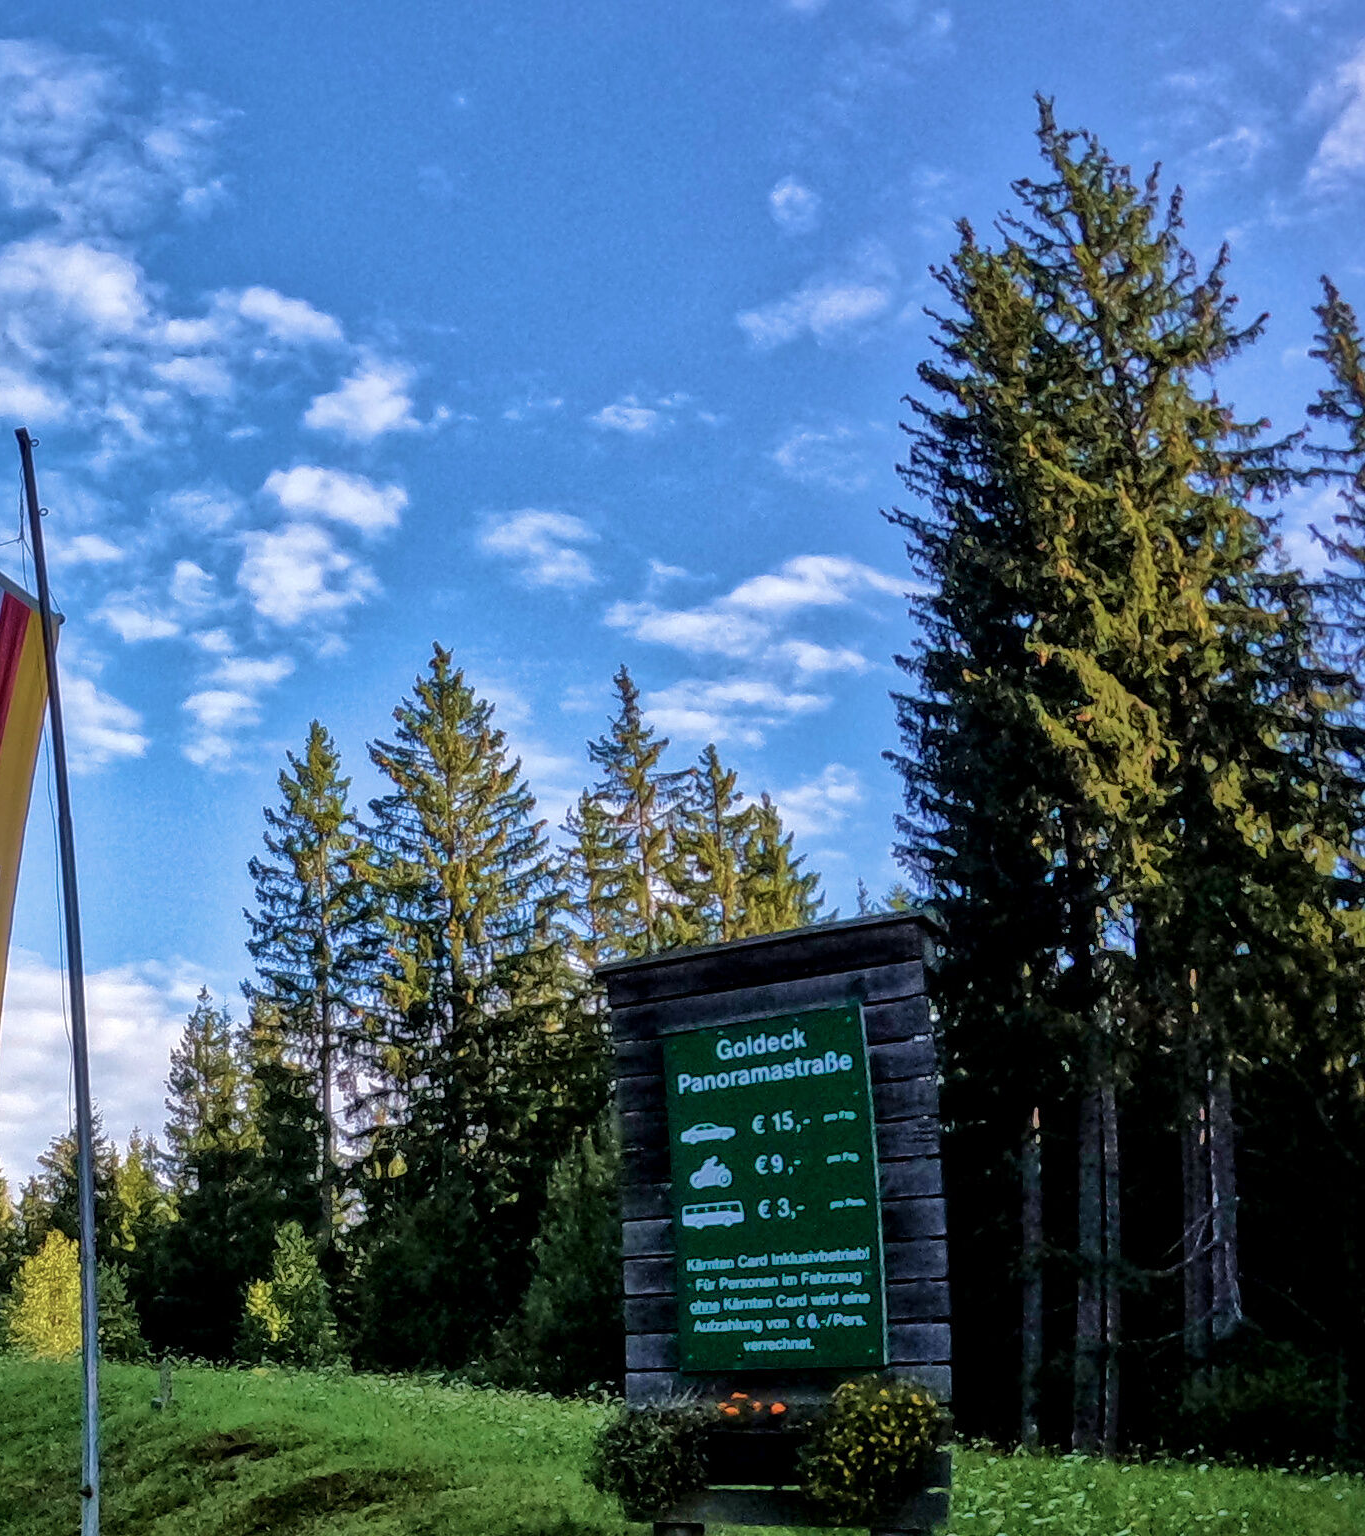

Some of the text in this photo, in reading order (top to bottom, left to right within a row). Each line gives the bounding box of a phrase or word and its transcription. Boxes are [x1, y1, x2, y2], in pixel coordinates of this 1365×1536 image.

[715, 1027, 808, 1061] Goldeck
[677, 1050, 854, 1095] Panoramastraße
[685, 1256, 735, 1272] Kärnten
[737, 1253, 769, 1268] Card
[695, 1271, 863, 1292] Für Personen im Fahrzeug
[689, 1291, 871, 1314] ohne Kärnten Card wird eine
[693, 1317, 764, 1334] Aufzahlung
[765, 1318, 790, 1330] von
[742, 1336, 816, 1352] verrechnet.
